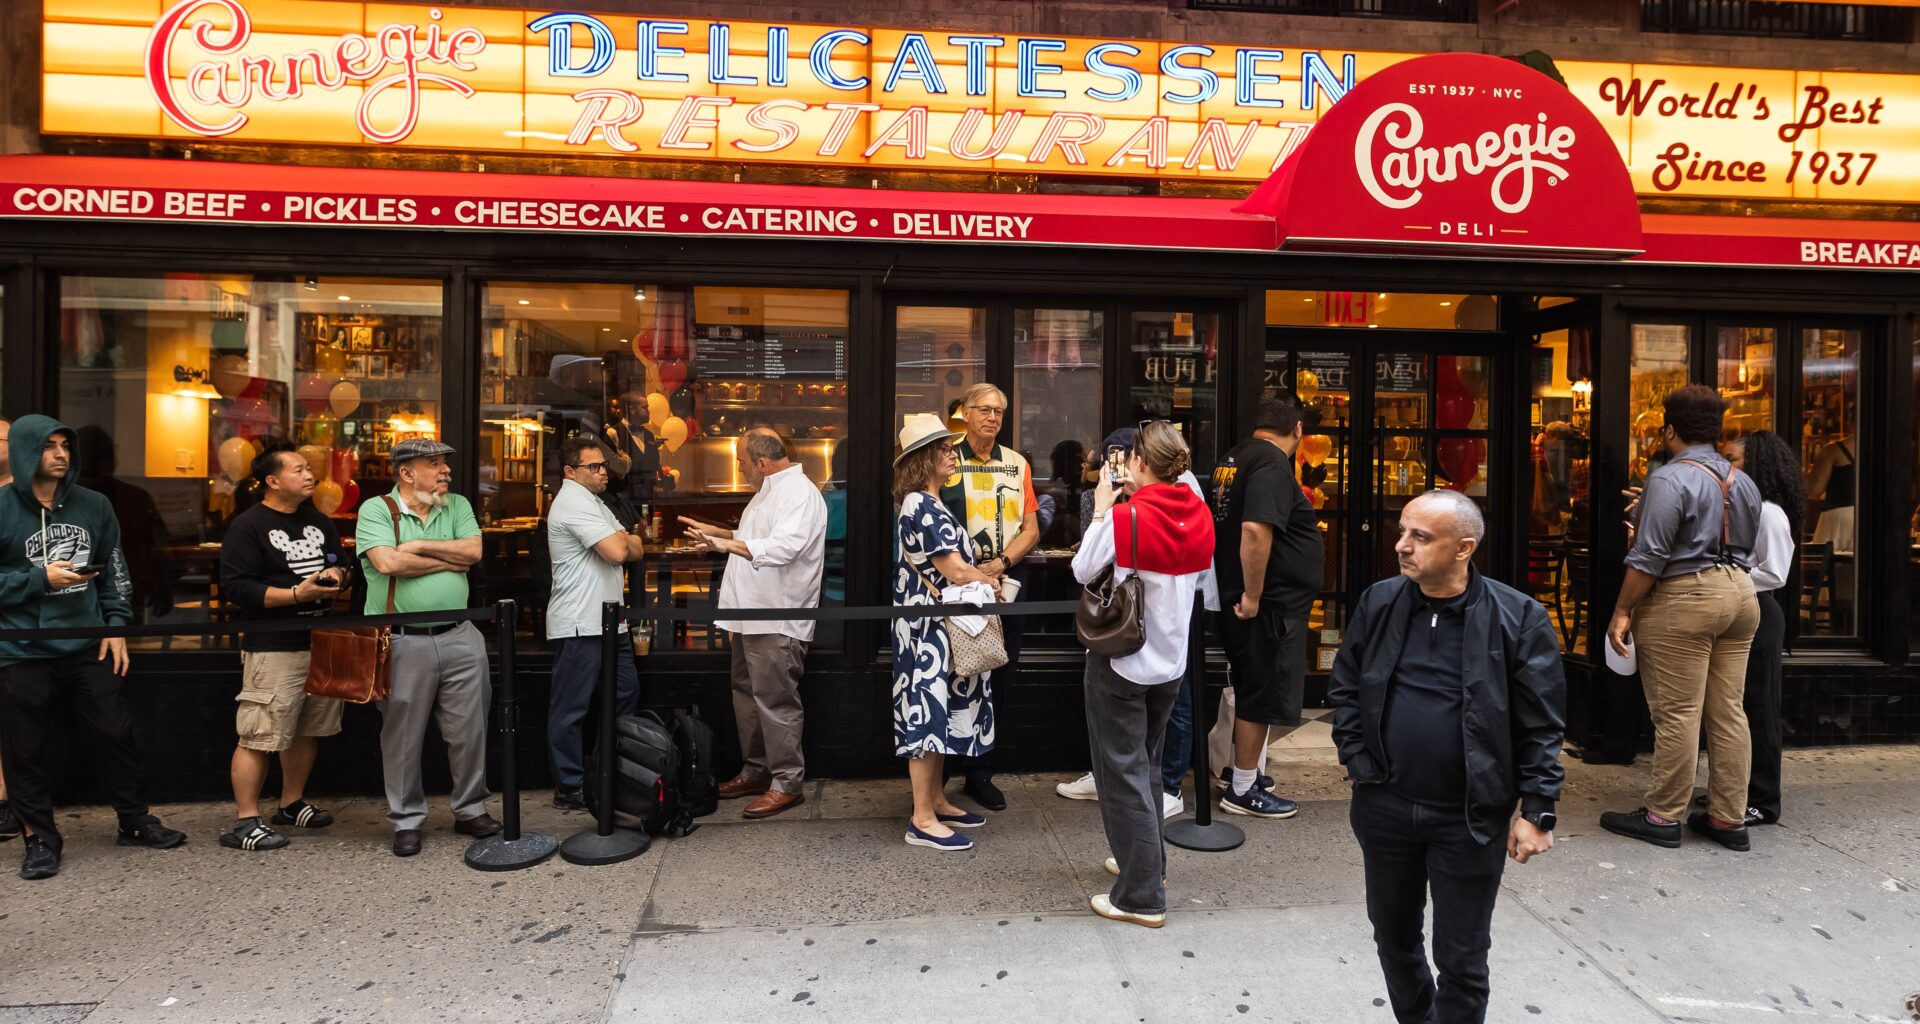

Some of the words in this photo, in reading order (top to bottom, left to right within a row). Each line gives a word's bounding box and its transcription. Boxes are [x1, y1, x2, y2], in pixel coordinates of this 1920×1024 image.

[144, 0, 486, 143] Carnegie
[526, 12, 1356, 111] DELICATESSEN
[1409, 83, 1436, 94] EST
[1442, 85, 1475, 96] 1937
[1493, 88, 1522, 99] NYC
[1599, 77, 1770, 120] World's
[1777, 85, 1884, 143] Best
[564, 88, 1316, 173] RESTAURANT
[1354, 102, 1576, 214] Carnegie
[1652, 142, 1767, 192] Since
[1785, 150, 1878, 186] 1937
[13, 187, 154, 213] CORNED
[164, 191, 247, 217] BEEF
[284, 196, 417, 222] PICKLES
[454, 200, 666, 229] CHEESECAKE
[701, 207, 858, 233] CATERING
[893, 212, 1034, 238] DELIVERY
[1439, 221, 1494, 237] DELI
[1800, 240, 1920, 265] BREAKFA
